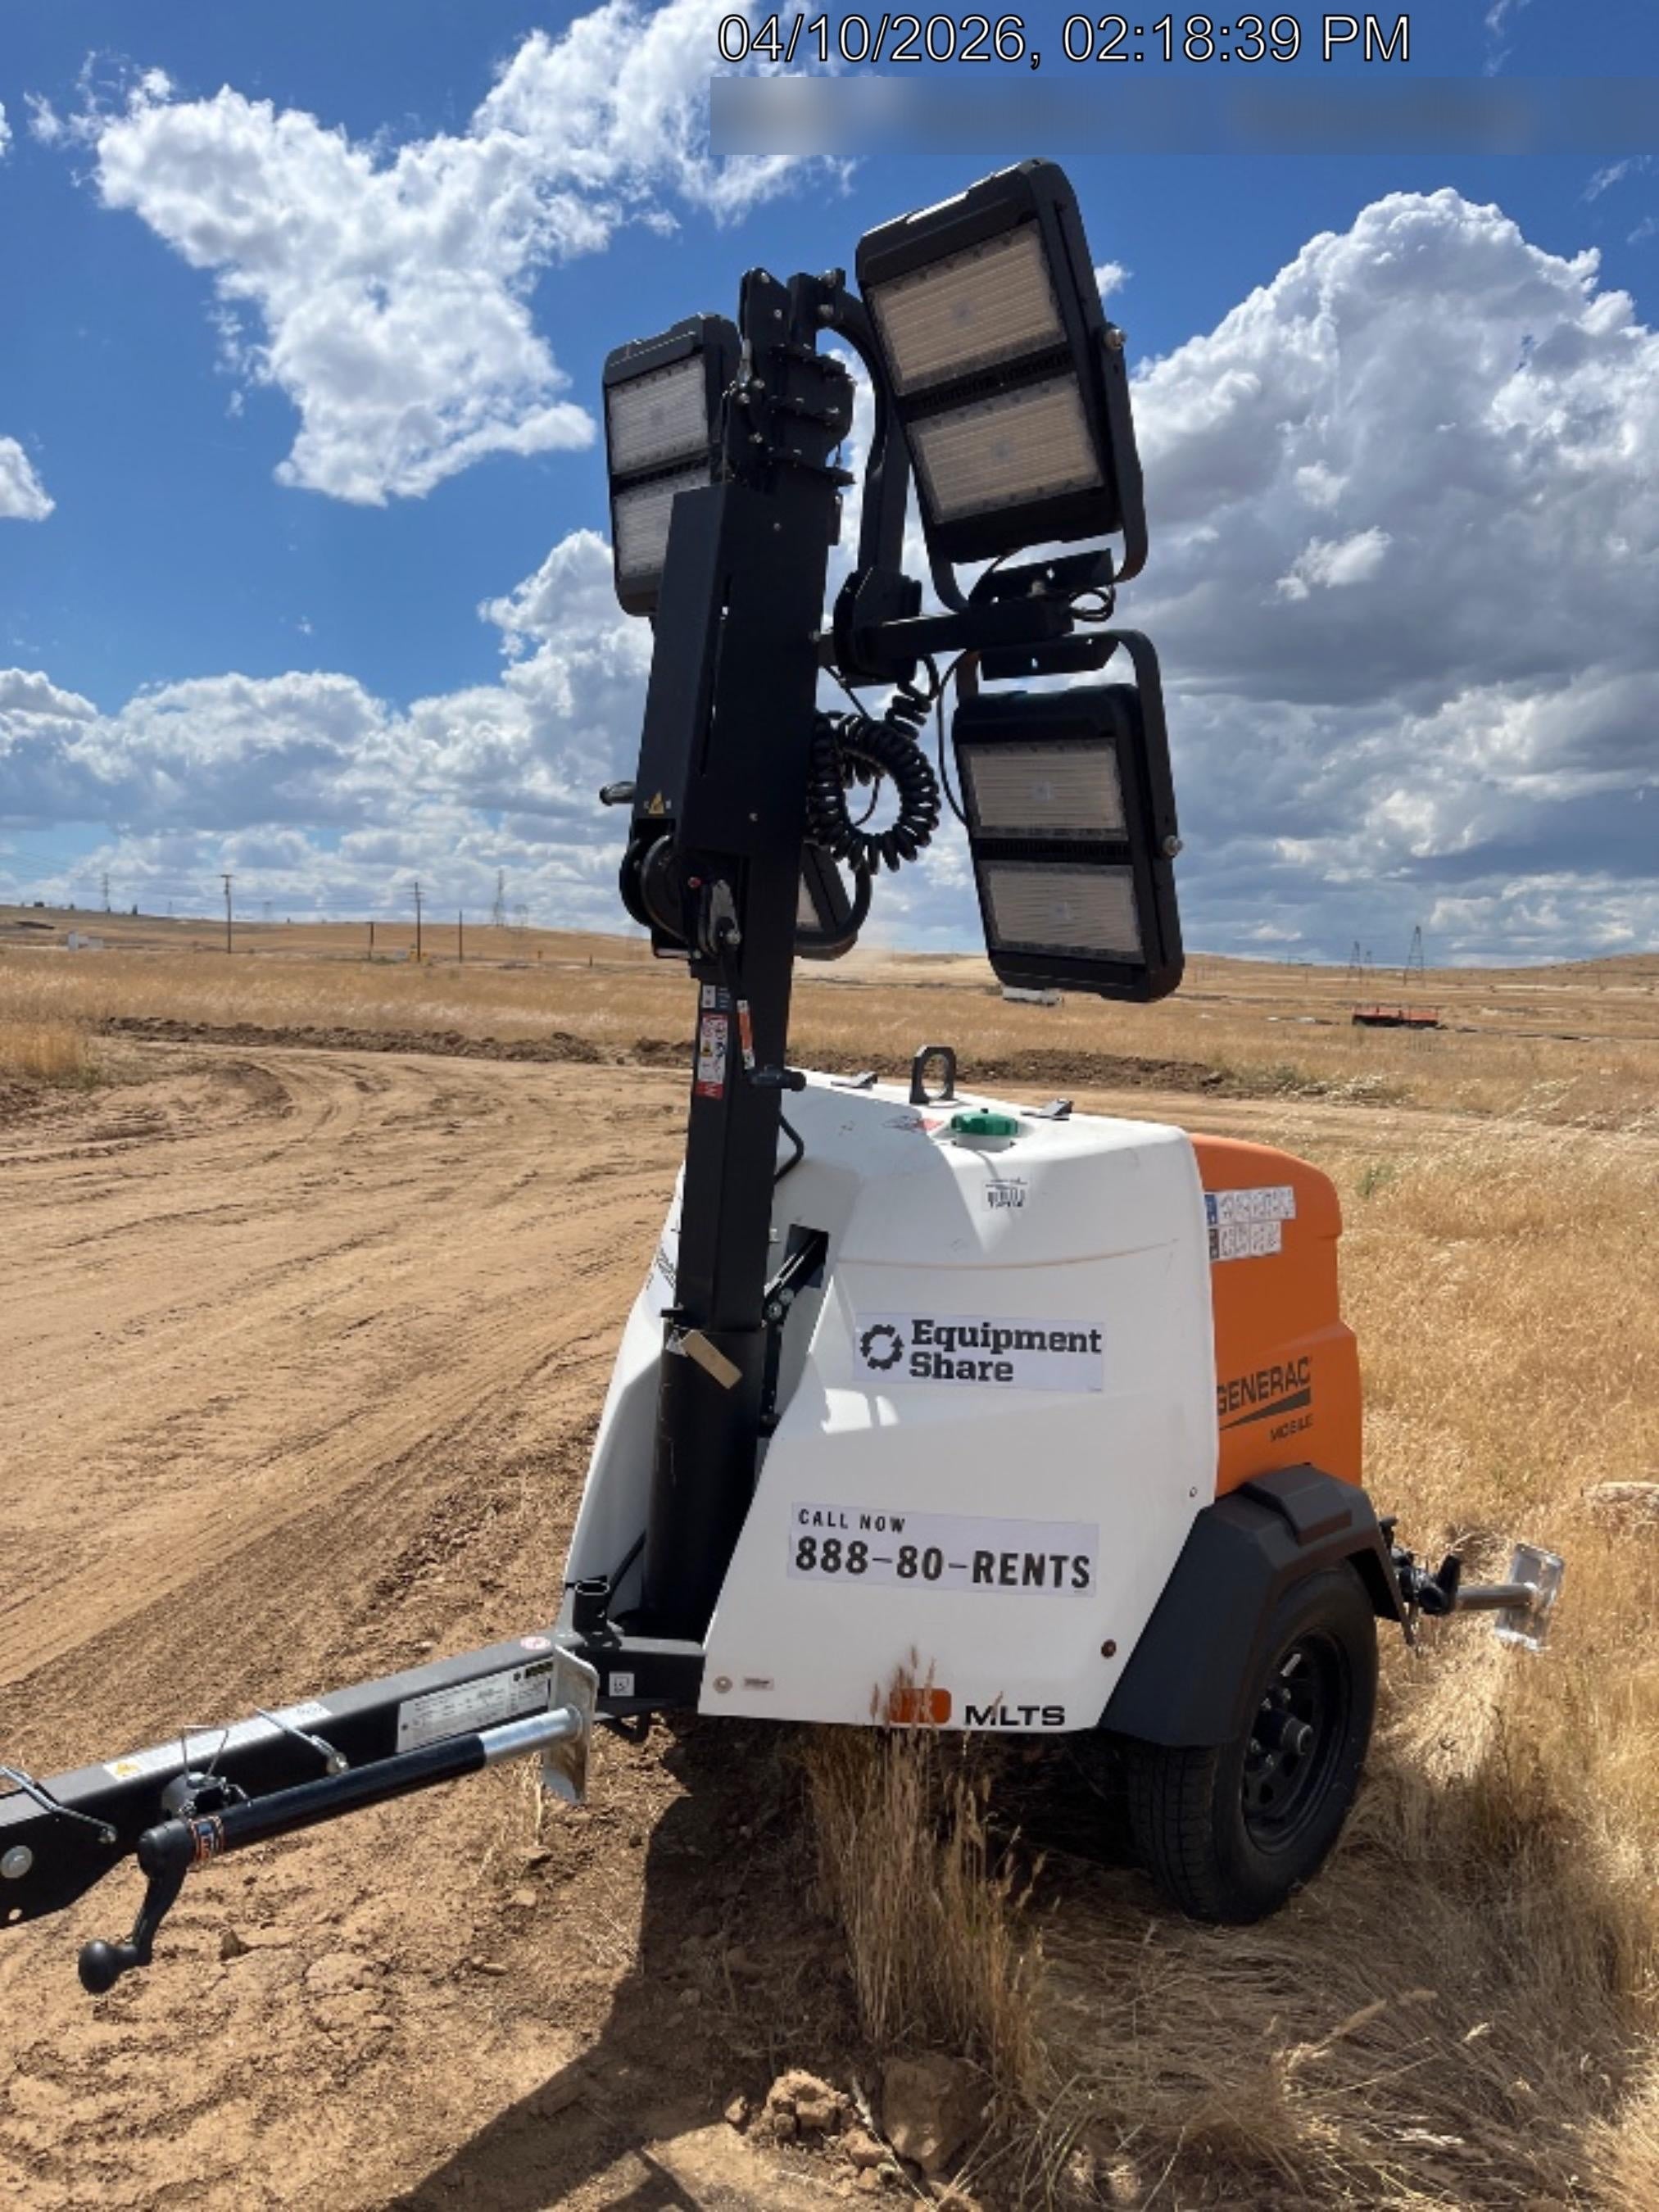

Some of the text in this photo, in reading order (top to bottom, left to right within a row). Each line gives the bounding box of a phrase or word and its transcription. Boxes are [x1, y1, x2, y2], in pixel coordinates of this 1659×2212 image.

[911, 1319, 1102, 1354] Equipment
[909, 1352, 1014, 1381] Share
[799, 1509, 906, 1534] CALL NOW
[796, 1535, 1090, 1589] 888-80-RENTS
[965, 1705, 1065, 1726] MLTS
